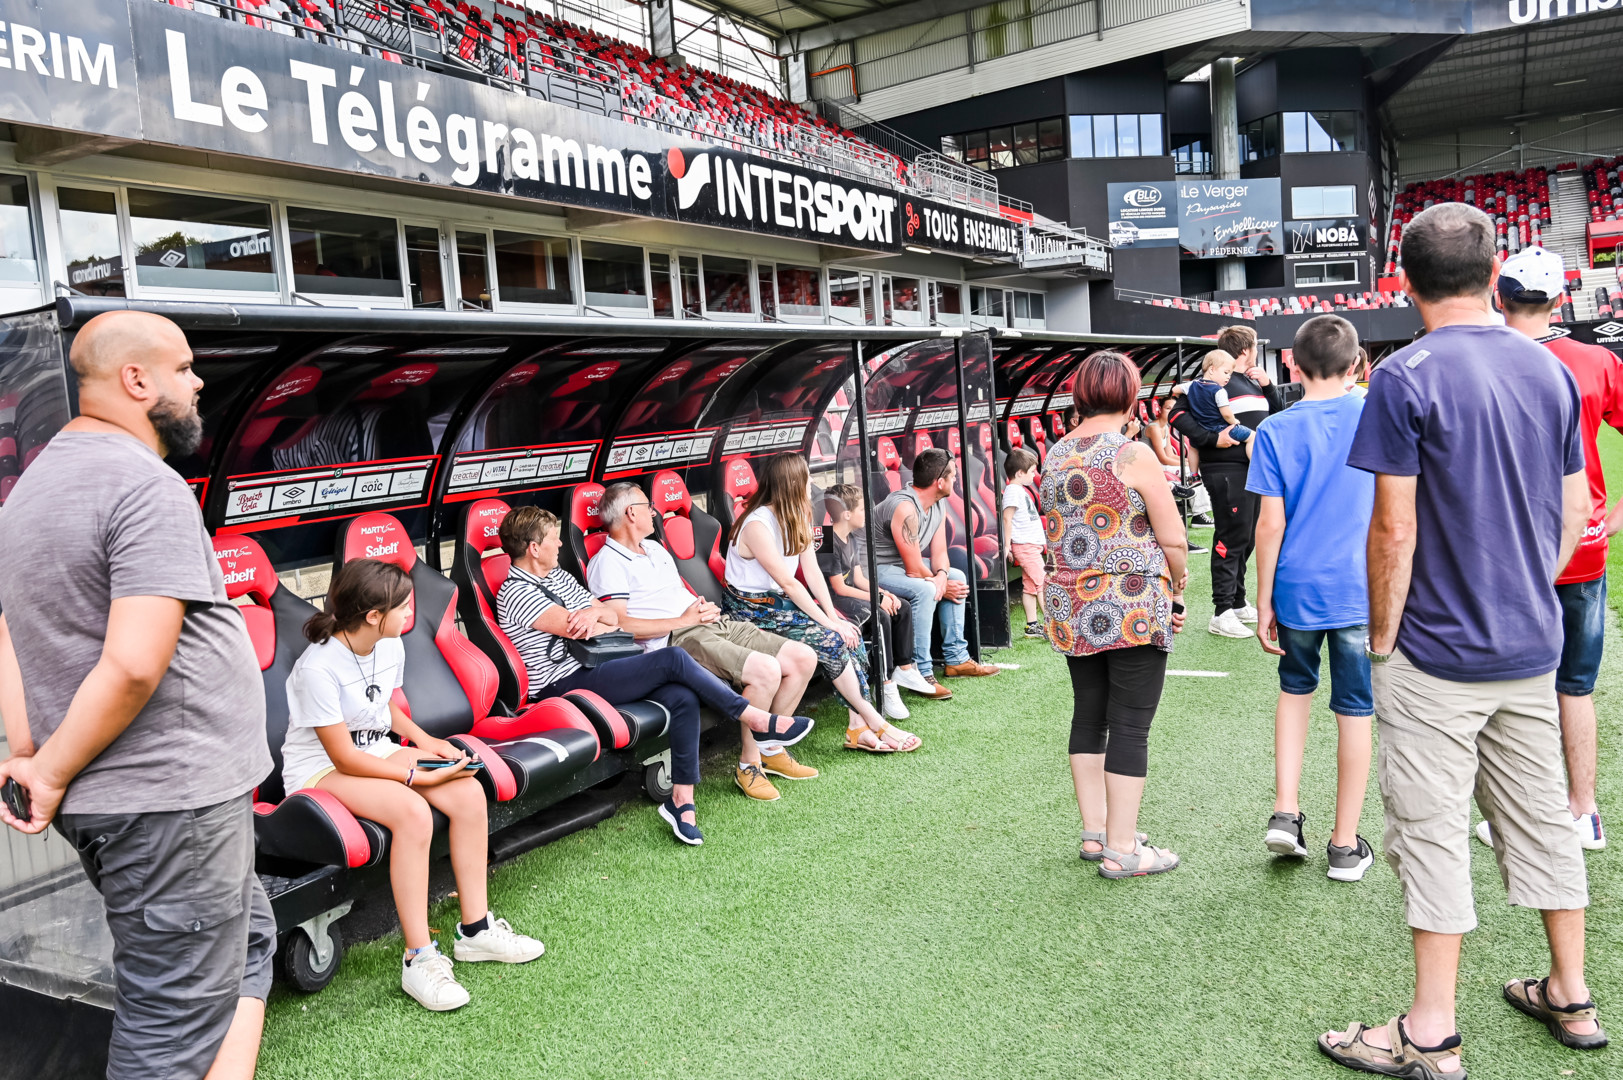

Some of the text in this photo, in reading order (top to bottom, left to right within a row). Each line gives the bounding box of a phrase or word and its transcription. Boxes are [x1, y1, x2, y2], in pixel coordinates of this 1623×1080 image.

[1509, 0, 1623, 24] um
[165, 29, 653, 200] Le Télégramme
[1137, 190, 1157, 200] BLC
[1183, 185, 1199, 198] Le
[1202, 184, 1248, 200] Verger
[714, 155, 894, 244] INTERSPORT
[923, 207, 959, 243] TOUS
[1209, 246, 1254, 256] PÉDERNEC
[492, 465, 507, 473] VITAL
[236, 490, 263, 506] Breizh
[664, 491, 683, 502] Sabelt
[240, 501, 258, 512] Cola
[586, 506, 600, 517] Sab
[479, 508, 498, 517] MARTY
[361, 525, 385, 535] MARTY
[483, 525, 500, 538] Sab
[375, 535, 384, 543] by
[365, 542, 399, 558] Sabelt
[227, 560, 237, 570] by
[223, 567, 256, 585] abelt
